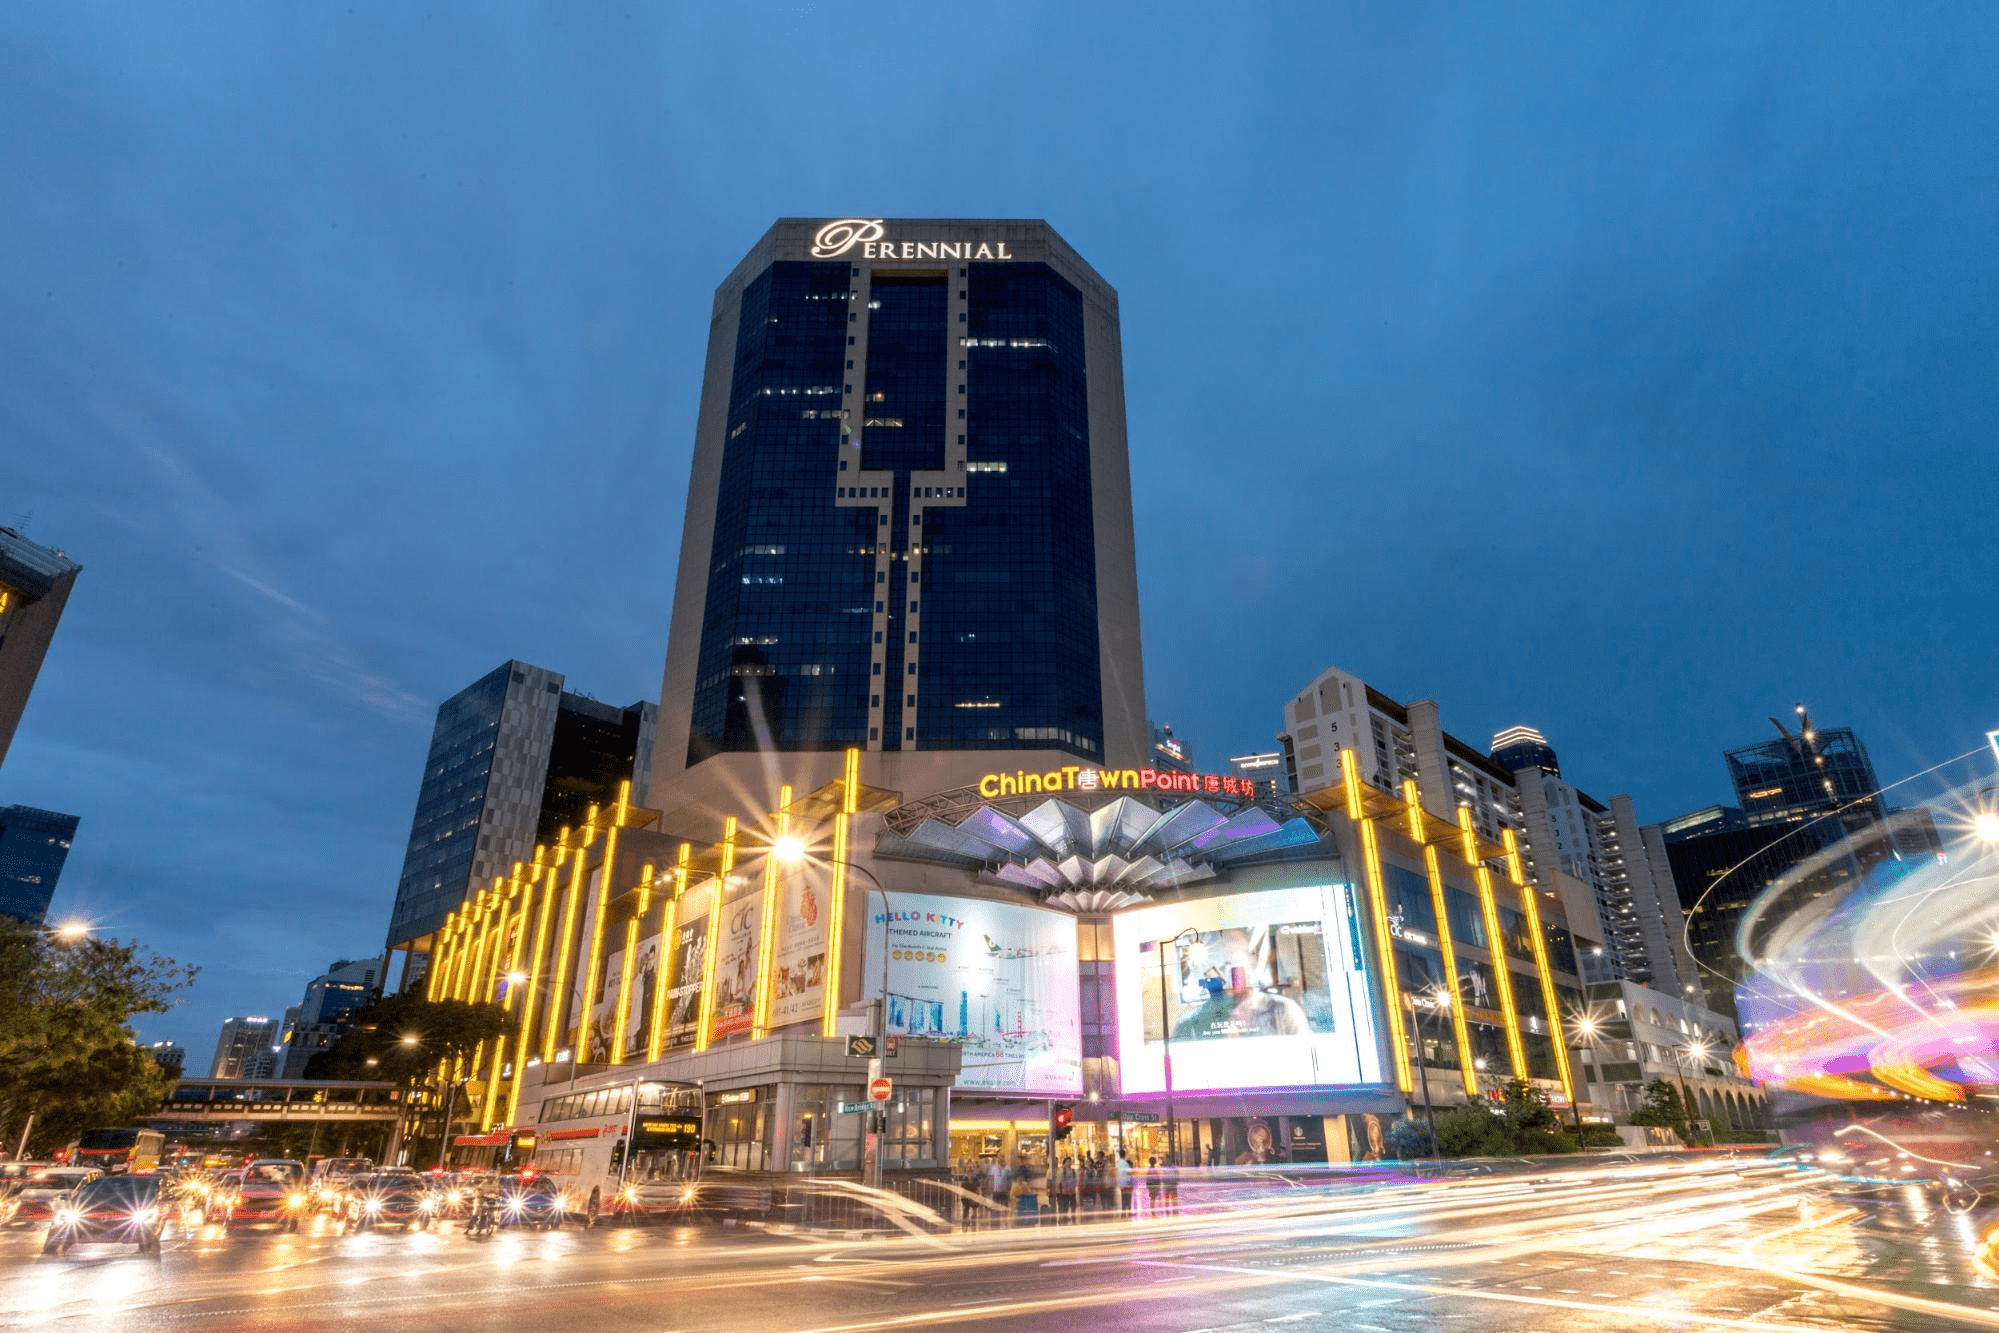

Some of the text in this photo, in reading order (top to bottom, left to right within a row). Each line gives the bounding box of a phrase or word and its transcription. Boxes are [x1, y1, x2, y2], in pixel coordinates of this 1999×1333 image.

[811, 219, 1012, 259] PERENNIAL
[875, 911, 964, 930] HELLO KITTY
[919, 930, 952, 939] AIRCRAFT
